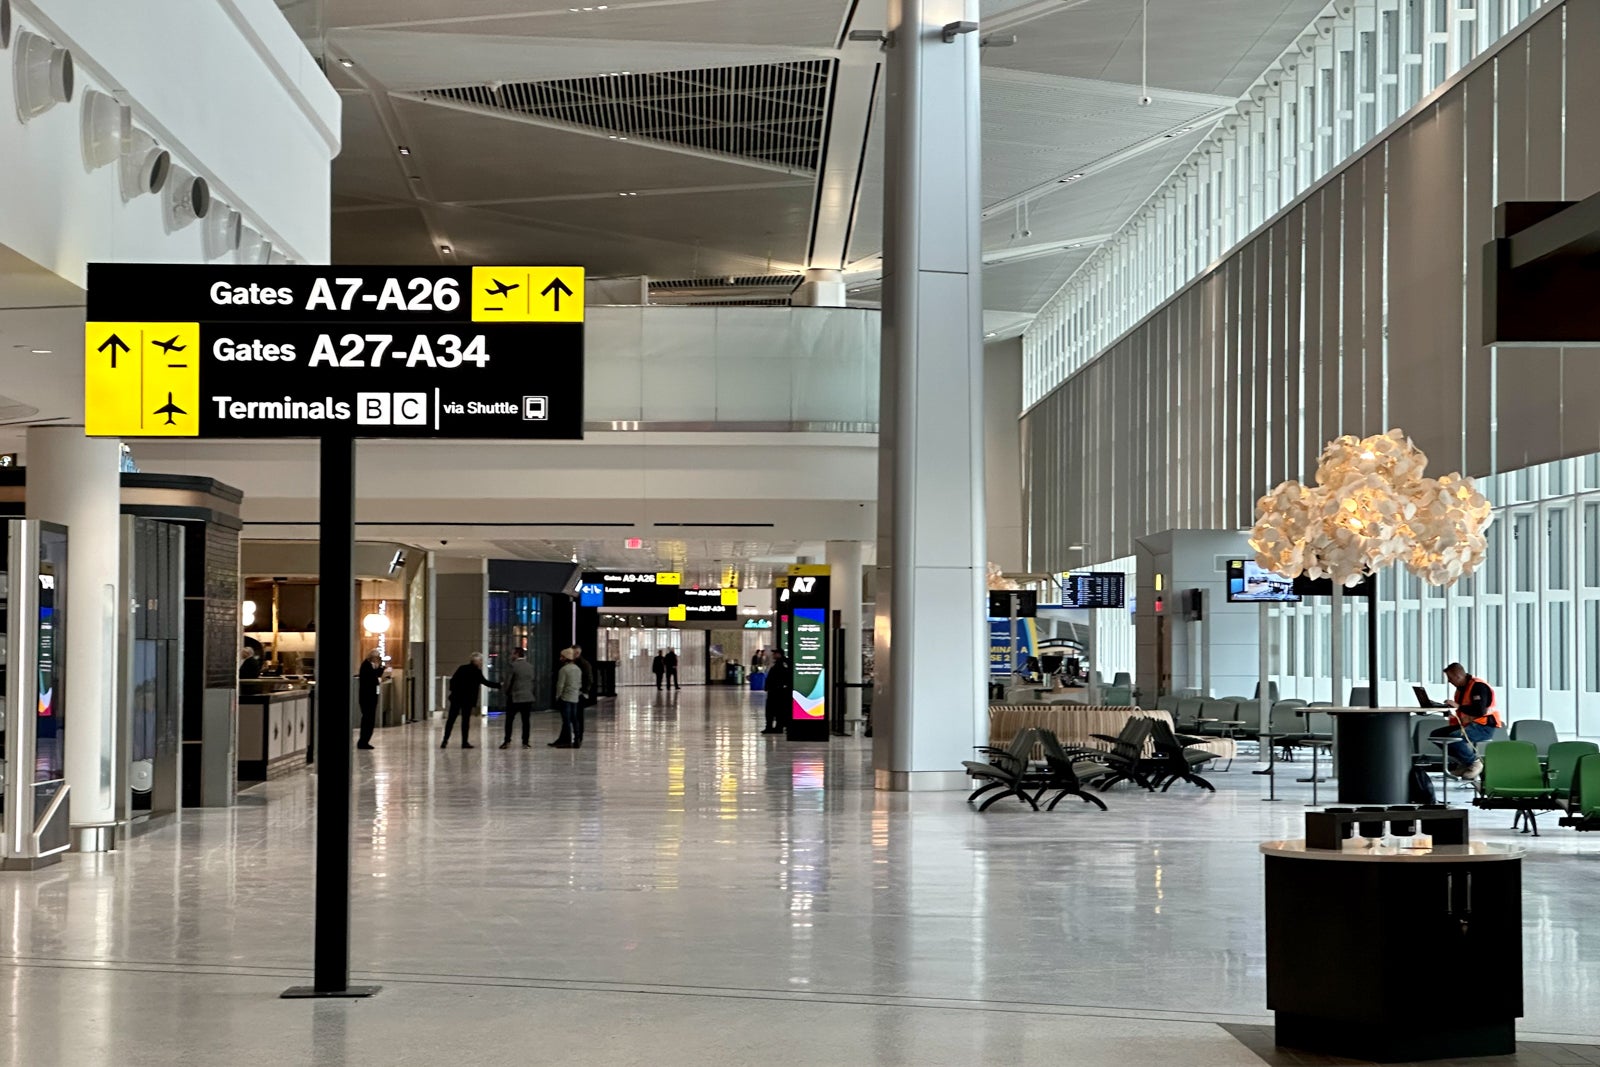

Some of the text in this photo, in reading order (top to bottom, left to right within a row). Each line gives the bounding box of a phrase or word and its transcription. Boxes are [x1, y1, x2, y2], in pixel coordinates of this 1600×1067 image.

[210, 278, 460, 311] Gates A7-A26
[213, 334, 490, 368] Gates A27-A34
[212, 396, 350, 419] Terminals
[443, 402, 464, 414] via
[467, 402, 518, 414] Shuttle
[793, 577, 816, 592] A7
